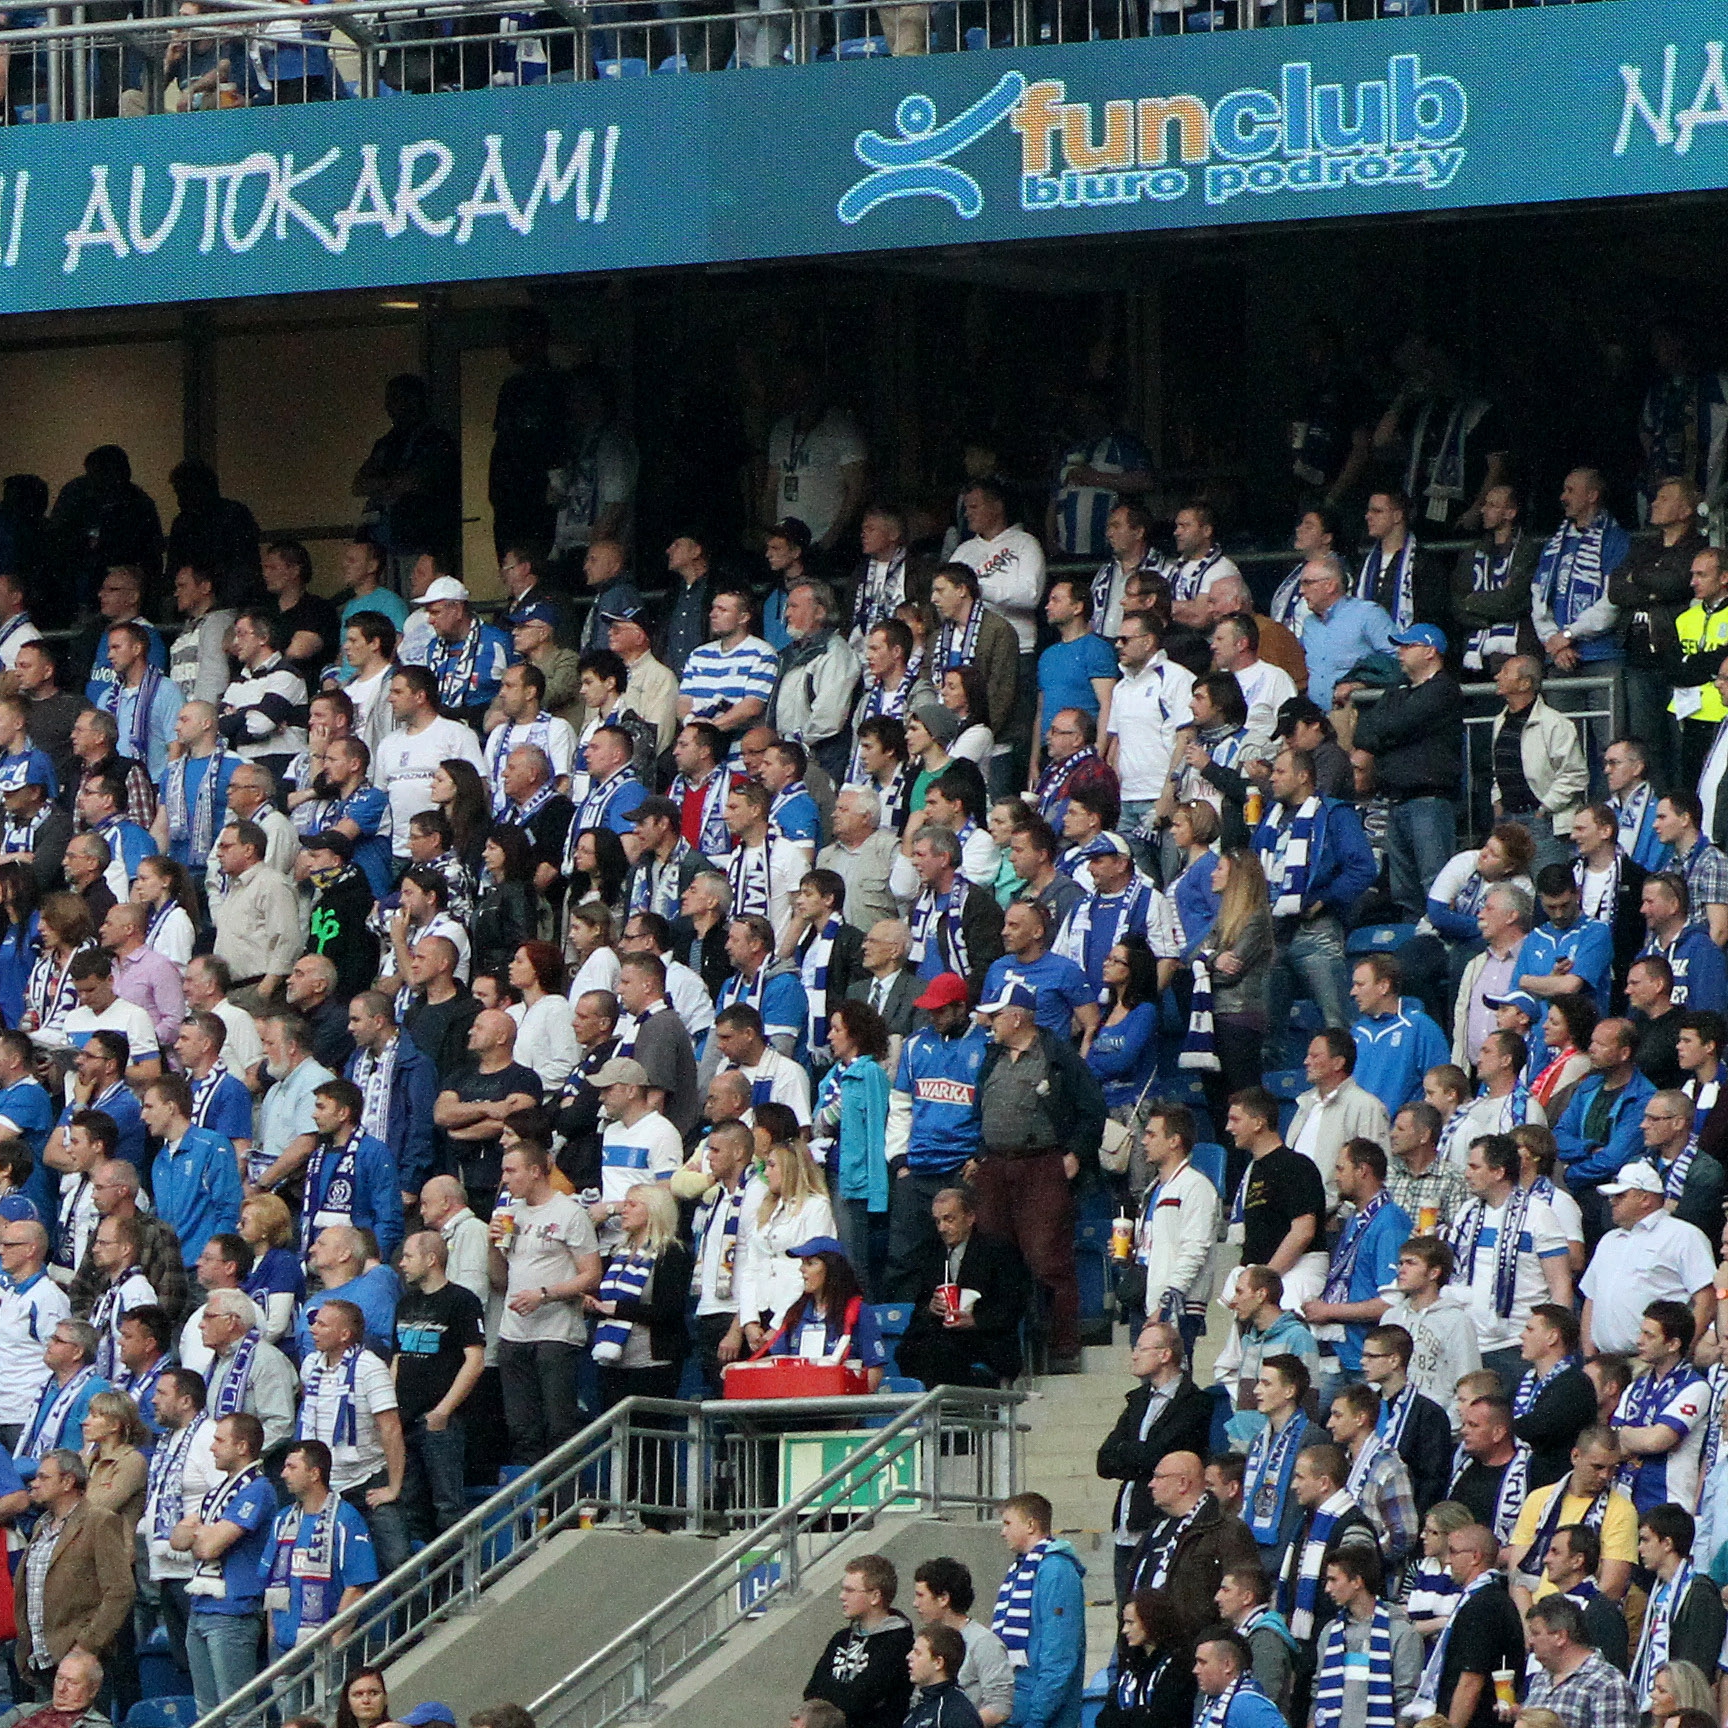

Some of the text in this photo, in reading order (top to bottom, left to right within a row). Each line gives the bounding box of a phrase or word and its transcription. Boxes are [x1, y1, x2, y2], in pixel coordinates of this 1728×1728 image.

[1012, 54, 1468, 176] funclub
[64, 124, 621, 274] AUTOKARAMI
[1021, 168, 1188, 209] biuro
[916, 1081, 972, 1103] WARKA
